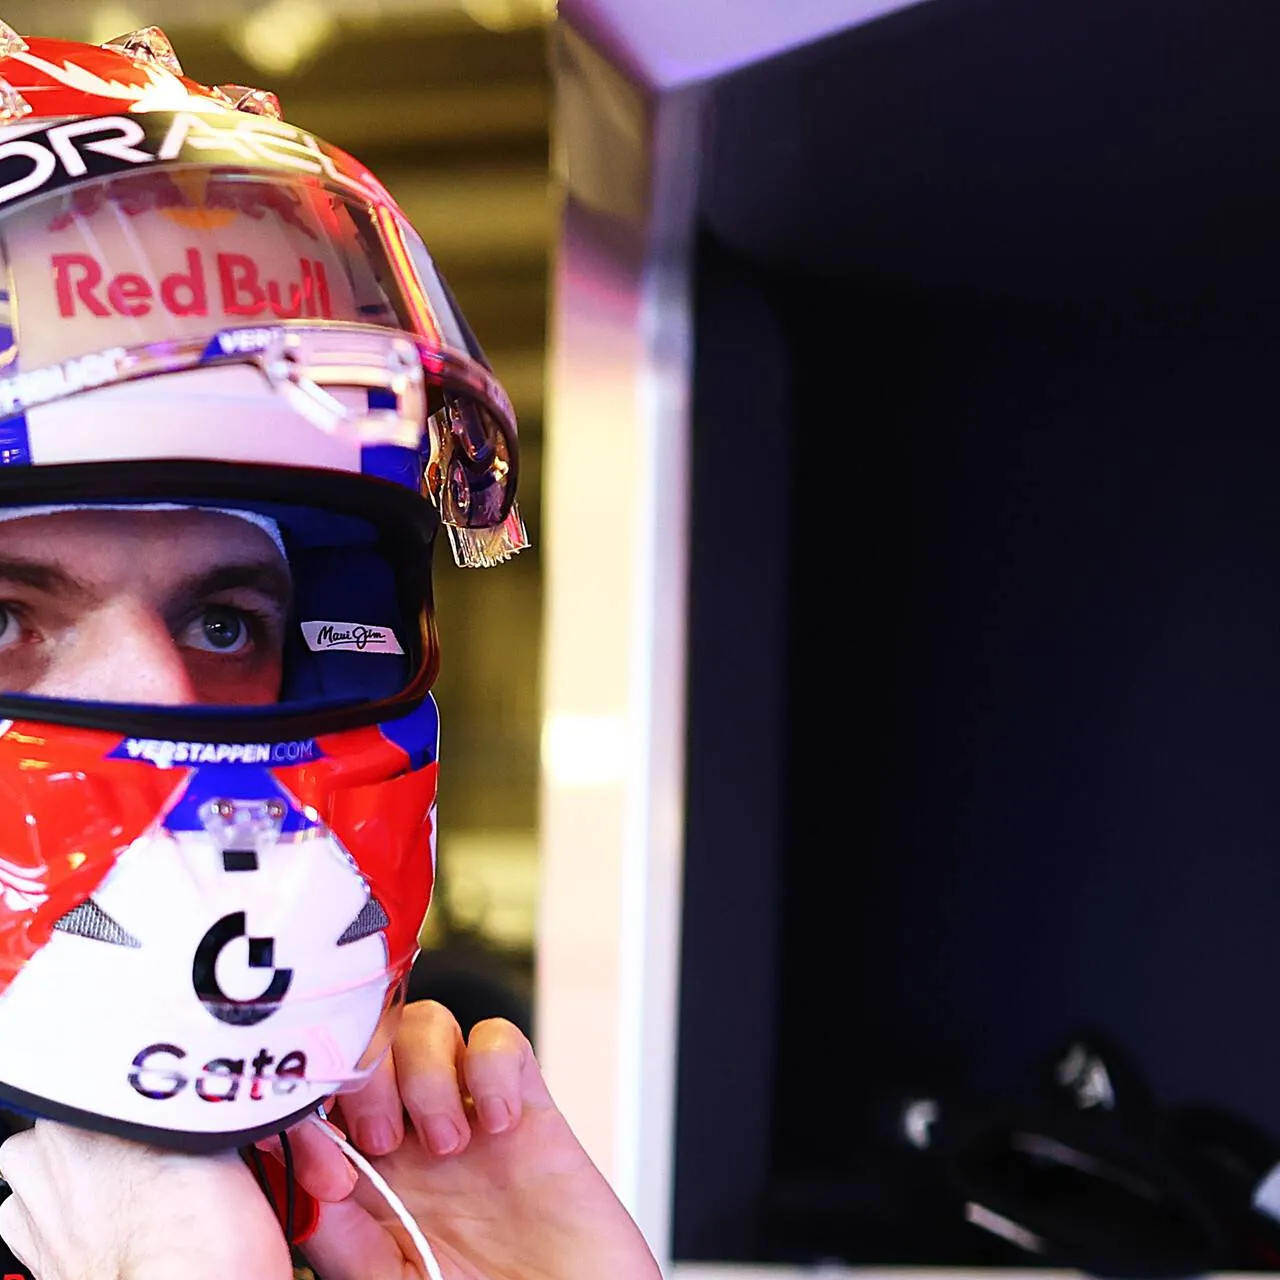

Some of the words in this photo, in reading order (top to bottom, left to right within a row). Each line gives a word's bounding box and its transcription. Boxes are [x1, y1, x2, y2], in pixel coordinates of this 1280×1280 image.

[51, 247, 208, 319] Red
[216, 252, 332, 319] Bull
[317, 625, 352, 645] Maui
[351, 626, 386, 650] Jim
[127, 1043, 309, 1103] Gate
